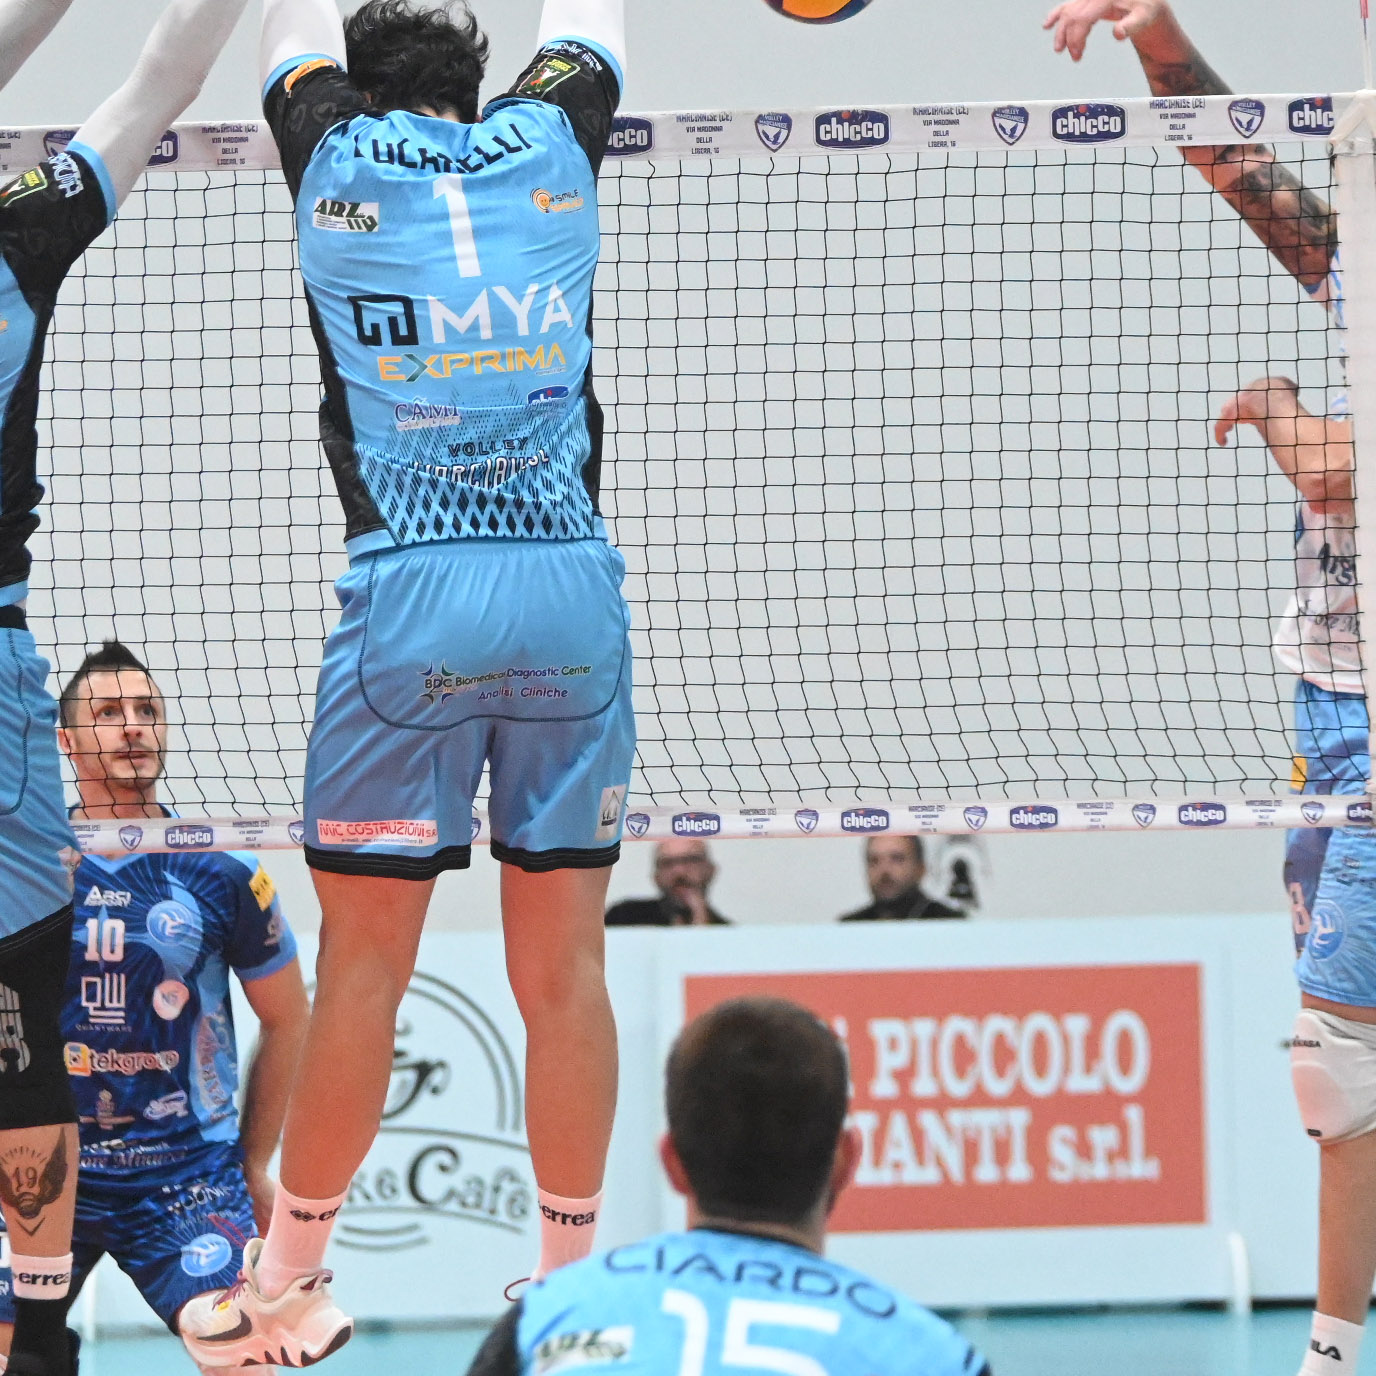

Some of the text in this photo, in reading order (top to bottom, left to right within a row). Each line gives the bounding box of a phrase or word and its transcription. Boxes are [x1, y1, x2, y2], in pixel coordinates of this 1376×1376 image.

[819, 110, 884, 139] chicco
[1056, 104, 1121, 136] chicco
[1293, 97, 1334, 128] chic
[606, 126, 647, 147] icco
[432, 173, 482, 278] 1
[427, 280, 573, 345] MYA
[377, 342, 566, 383] EXPRIMA
[448, 437, 529, 457] VOLLEY
[507, 666, 559, 679] Diagnostic
[561, 665, 592, 675] Center
[478, 686, 568, 701] Analisi Cliniche
[674, 813, 718, 832] chicco
[843, 808, 887, 828] chicco
[1012, 806, 1056, 826] chicco
[1180, 803, 1224, 822] chicco
[167, 826, 211, 845] chicco
[346, 821, 425, 837] COSTRUZIONI
[84, 917, 126, 962] 10
[870, 1009, 1152, 1099] PICCOLO
[1048, 1103, 1162, 1182] s.r.l.
[12, 1165, 39, 1190] 19
[541, 1204, 596, 1226] errea
[605, 1244, 898, 1320] CIARDO
[661, 1288, 842, 1376] 15
[1311, 1338, 1342, 1362] ILA
